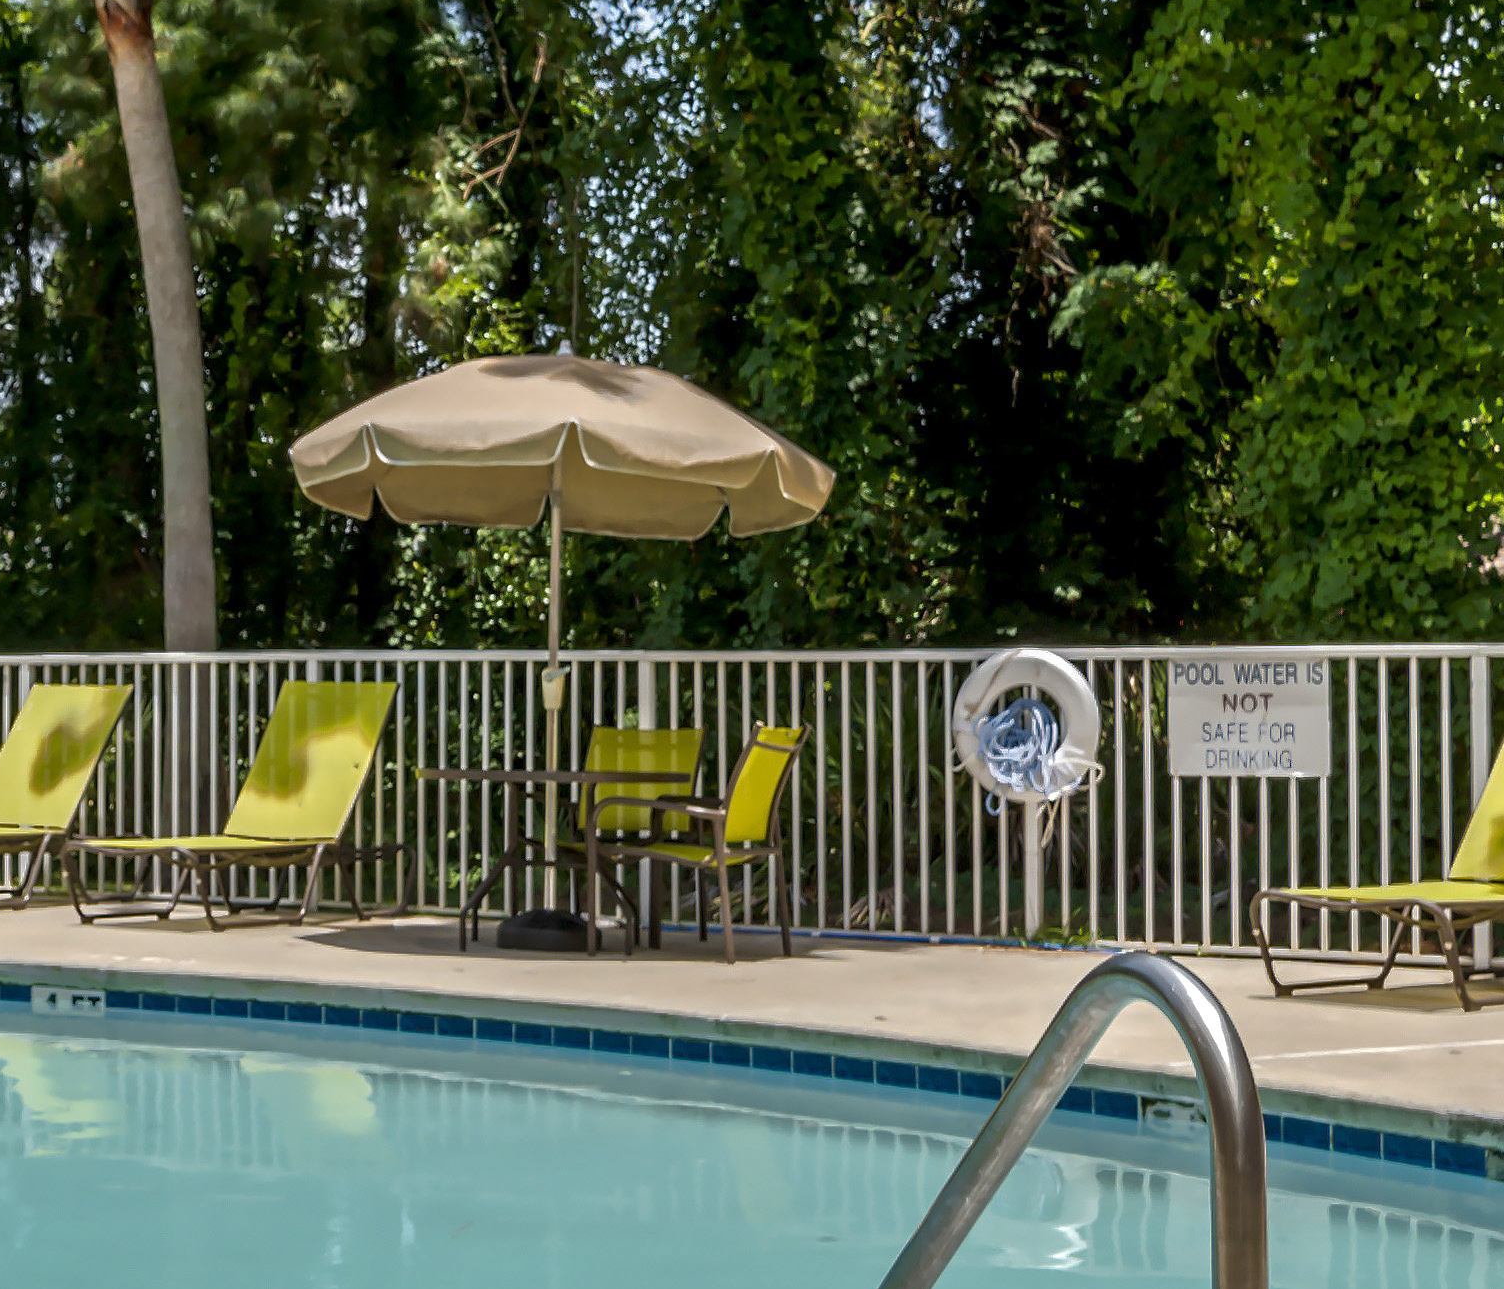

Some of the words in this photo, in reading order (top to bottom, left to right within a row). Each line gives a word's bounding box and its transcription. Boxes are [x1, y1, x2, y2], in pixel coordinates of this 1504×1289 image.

[1174, 663, 1224, 685] POOL
[1234, 663, 1297, 685] WATER
[1306, 662, 1324, 685] IS
[1222, 693, 1273, 713] NOT
[1202, 722, 1248, 743] SAFE
[1259, 723, 1295, 743] FOR
[1206, 750, 1292, 769] DRINKING
